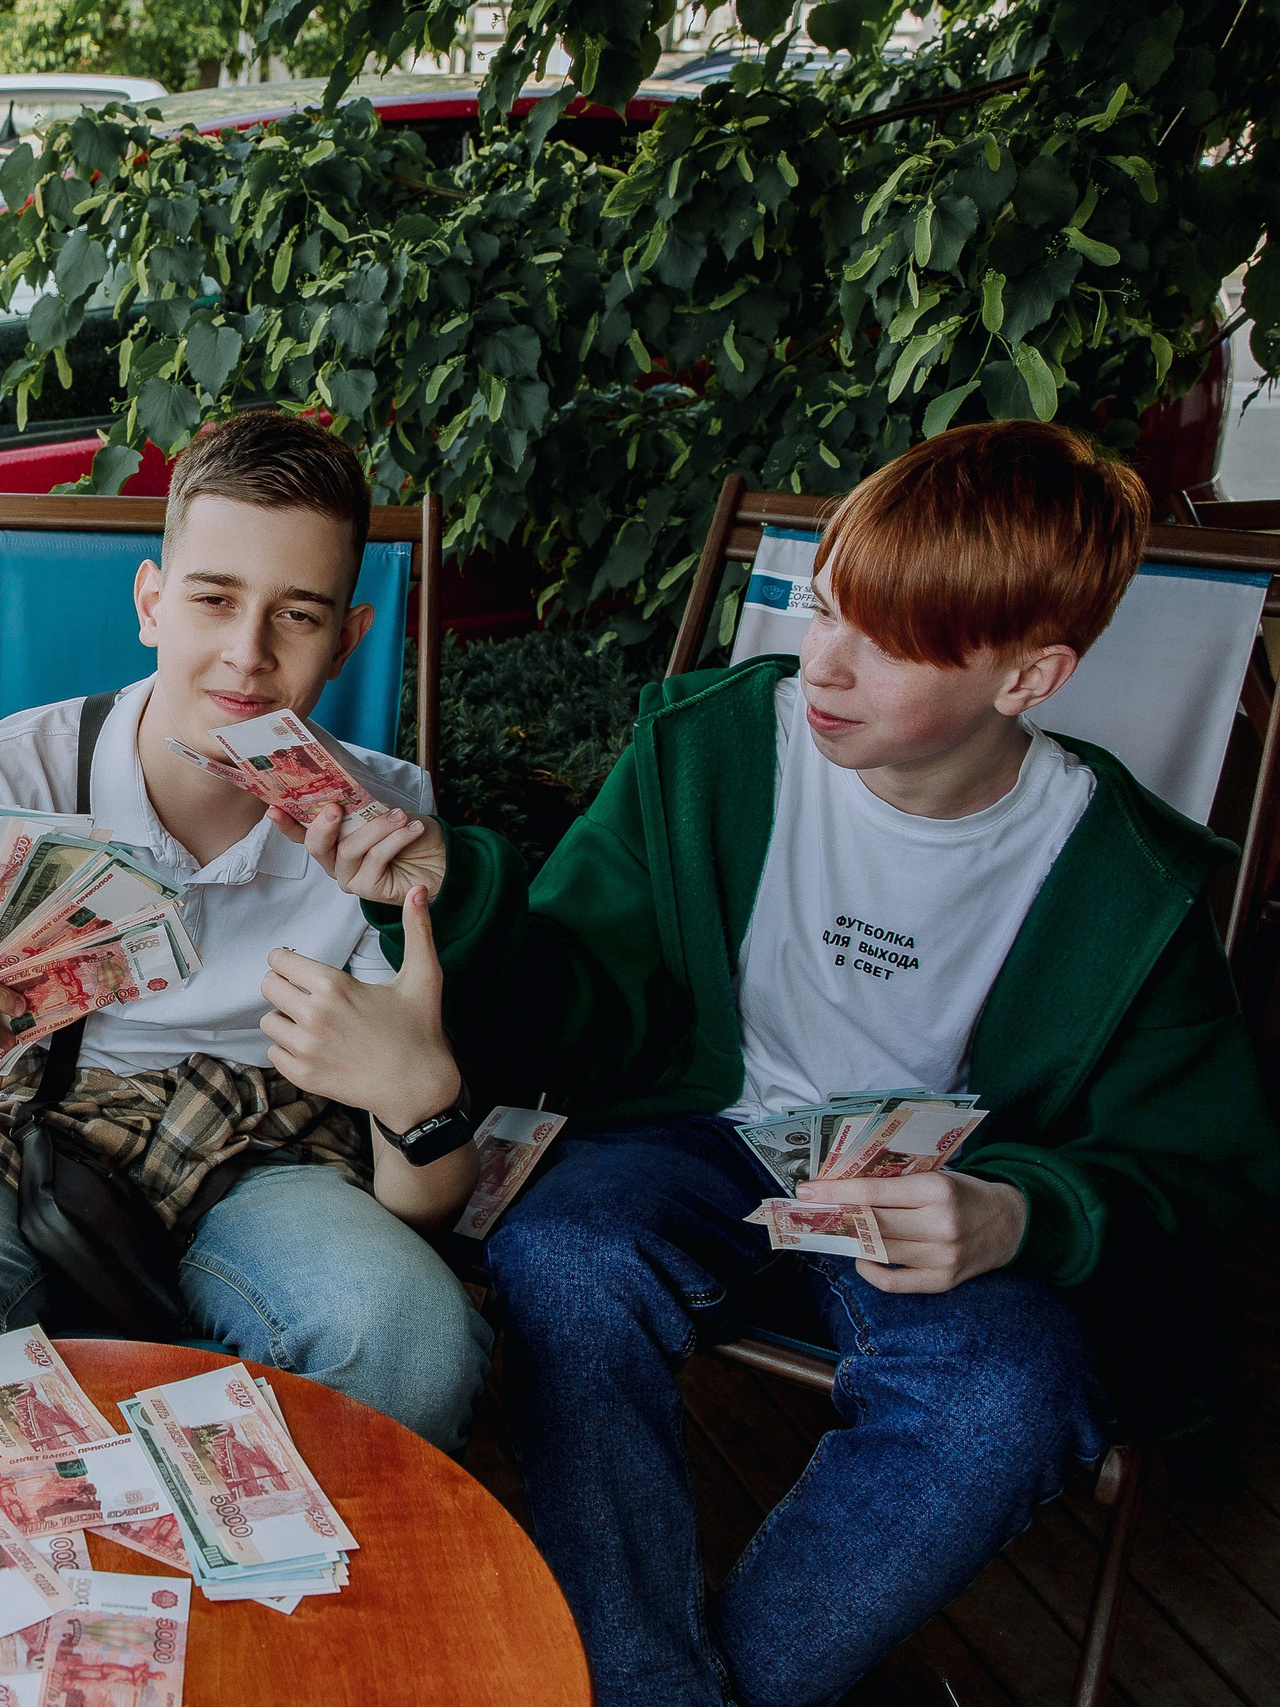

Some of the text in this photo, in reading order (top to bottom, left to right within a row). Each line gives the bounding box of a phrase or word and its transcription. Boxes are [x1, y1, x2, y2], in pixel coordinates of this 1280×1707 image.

[31, 872, 114, 940] БИЛЕТ БАНКА ПРИКОЛОВ
[836, 915, 915, 949] ФУТБОЛКА
[822, 930, 920, 970] ДЛЯ ВЫХОДА
[835, 954, 895, 980] В СВЕТ
[95, 986, 140, 1009] 5000
[940, 1128, 962, 1151] 5000
[26, 1340, 51, 1367] 5000
[229, 1380, 253, 1408] 5000
[150, 1398, 168, 1420] ПЯТЬ
[165, 1420, 188, 1448] ТЫСЯЧ
[9, 1437, 132, 1466] БИЛЕТ БАНКА ПРИКОЛОВ
[210, 1493, 254, 1539] 5000
[308, 1508, 336, 1538] 5000
[49, 1537, 81, 1574] 000
[153, 1617, 177, 1664] 5000
